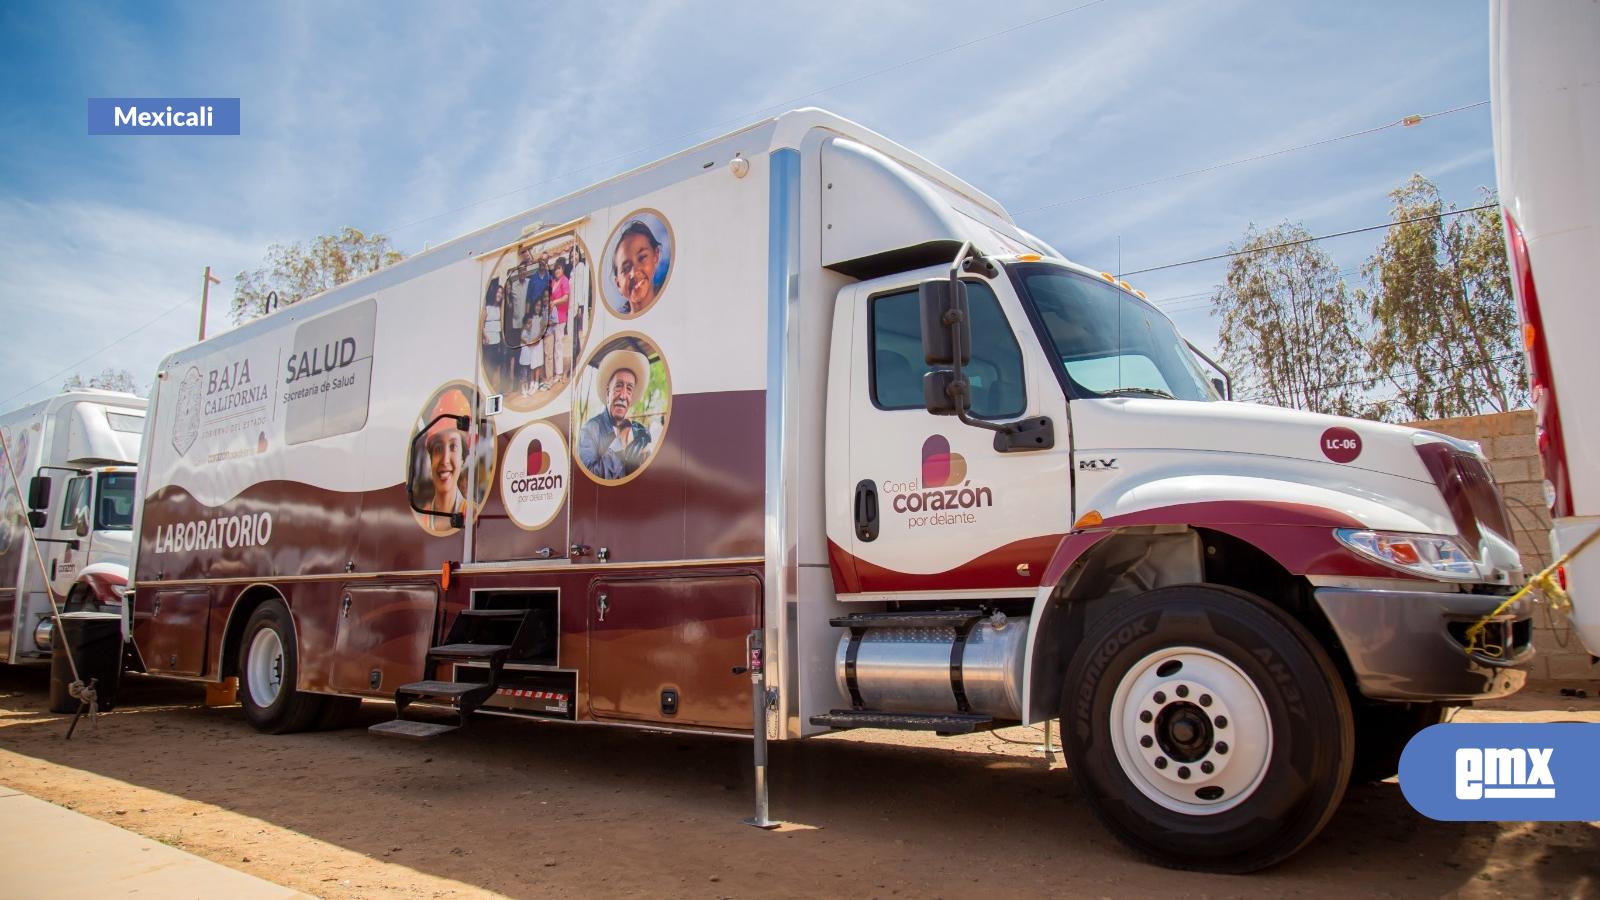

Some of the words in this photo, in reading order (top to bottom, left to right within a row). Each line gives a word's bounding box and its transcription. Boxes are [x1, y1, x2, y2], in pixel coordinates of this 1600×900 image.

[285, 336, 356, 384] SALUD
[207, 358, 250, 395] BAJA
[320, 381, 331, 393] de
[332, 373, 355, 391] Salud
[204, 384, 268, 416] CALIFORNIA
[1327, 439, 1357, 449] LC-06
[1079, 458, 1117, 469] MV
[511, 470, 562, 493] corazón
[883, 480, 907, 493] Con
[908, 478, 918, 491] el
[893, 480, 992, 513] corazón
[155, 512, 272, 553] LABORATORIO
[908, 515, 928, 529] por
